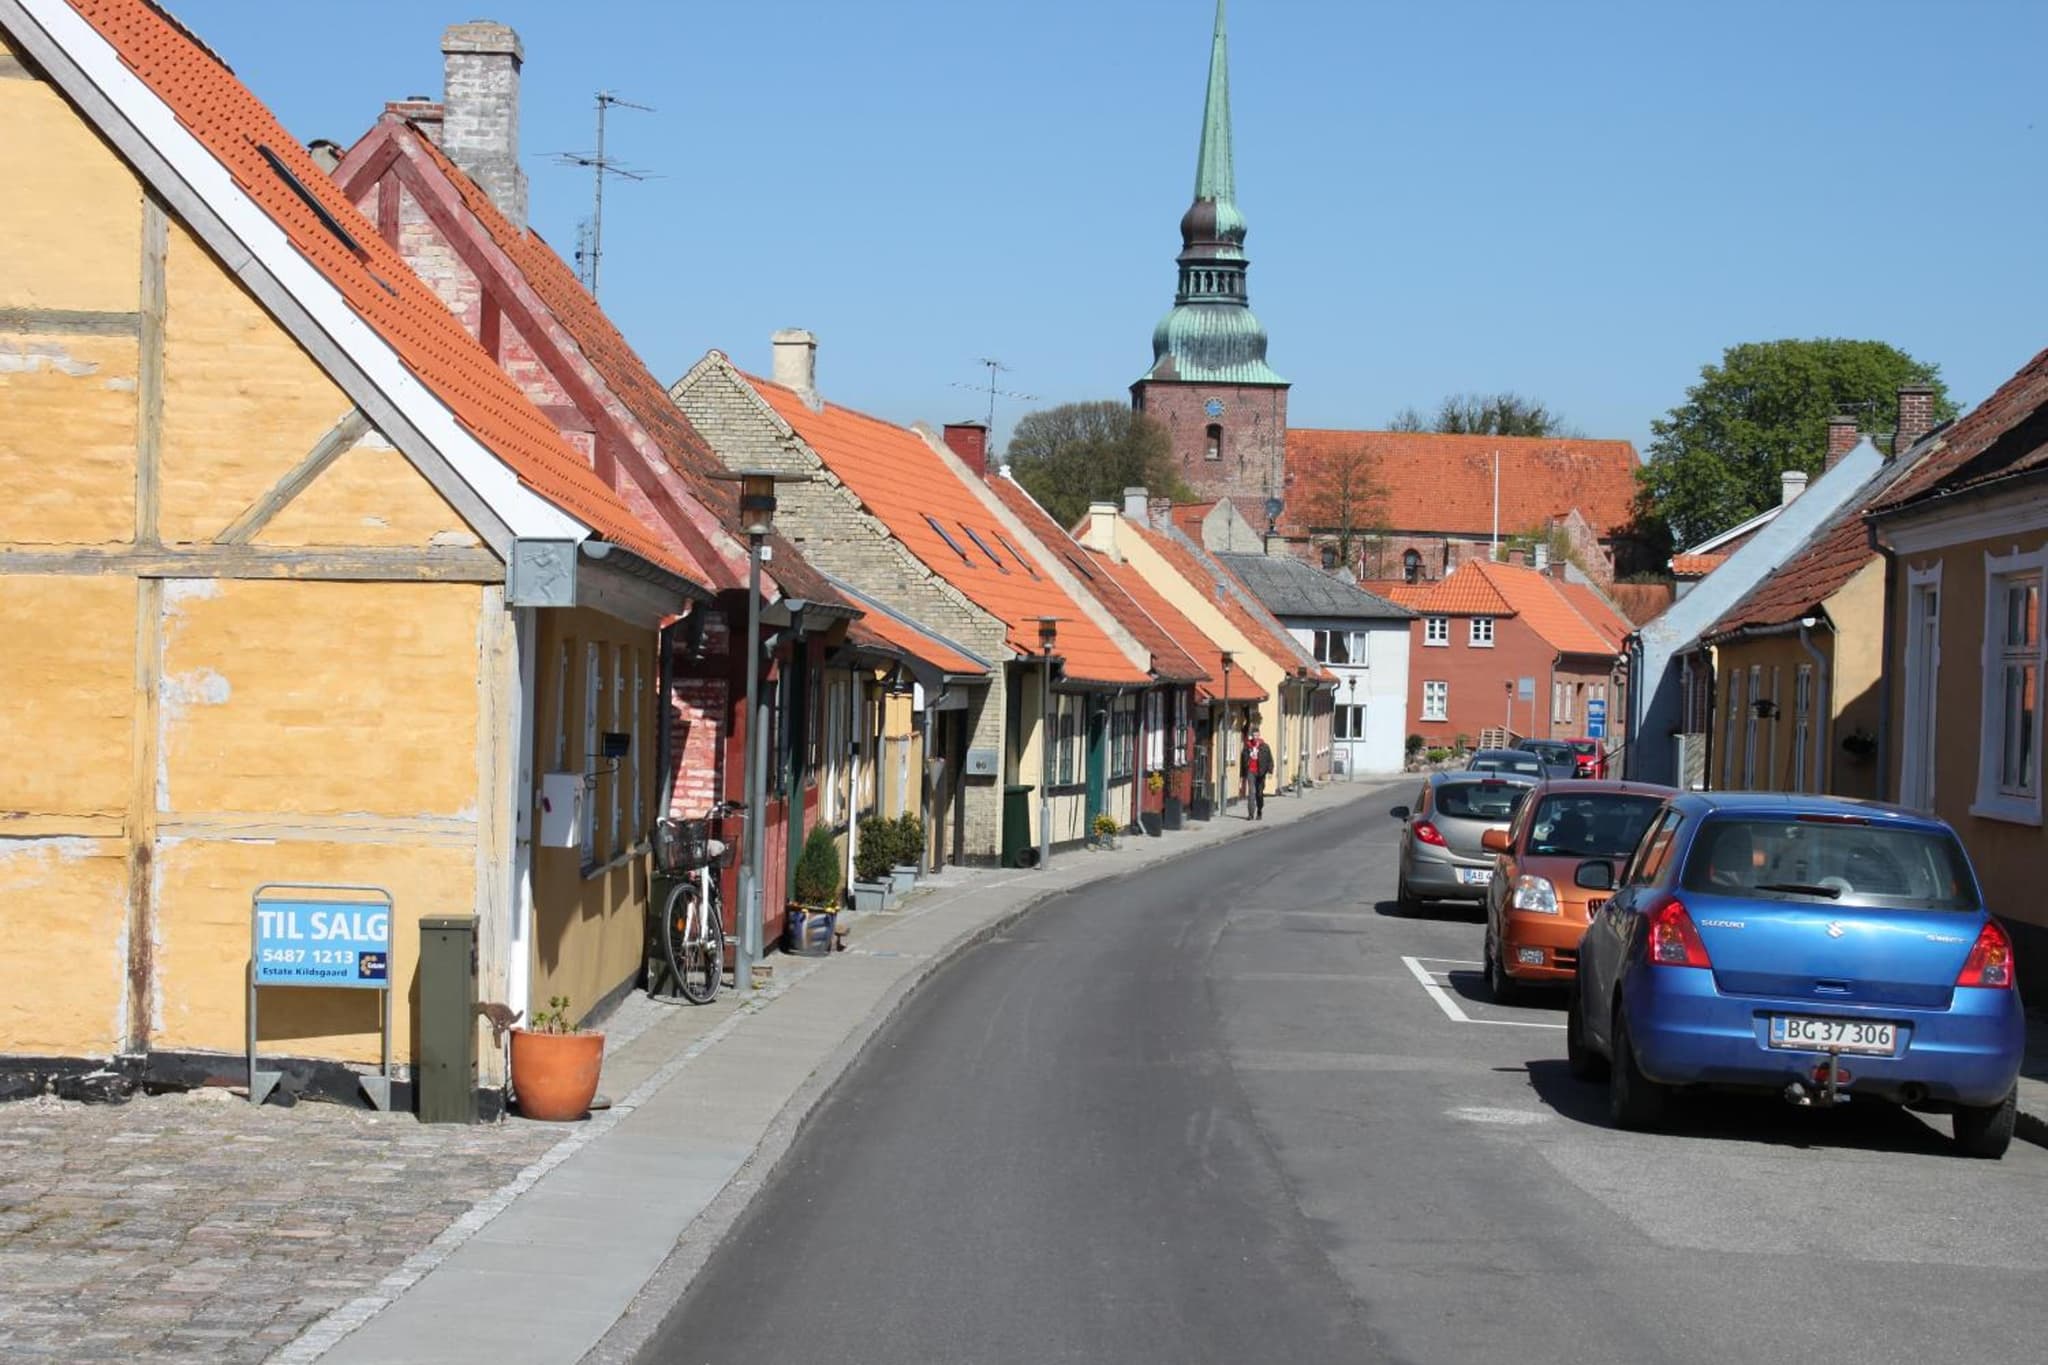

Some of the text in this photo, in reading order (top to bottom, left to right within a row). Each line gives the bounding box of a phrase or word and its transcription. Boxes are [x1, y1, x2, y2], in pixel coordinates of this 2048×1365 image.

[258, 911, 388, 942] TIL SALG
[263, 948, 354, 965] 5487 1213
[263, 967, 293, 976] Estate
[1788, 1021, 1891, 1045] BG 37 306
